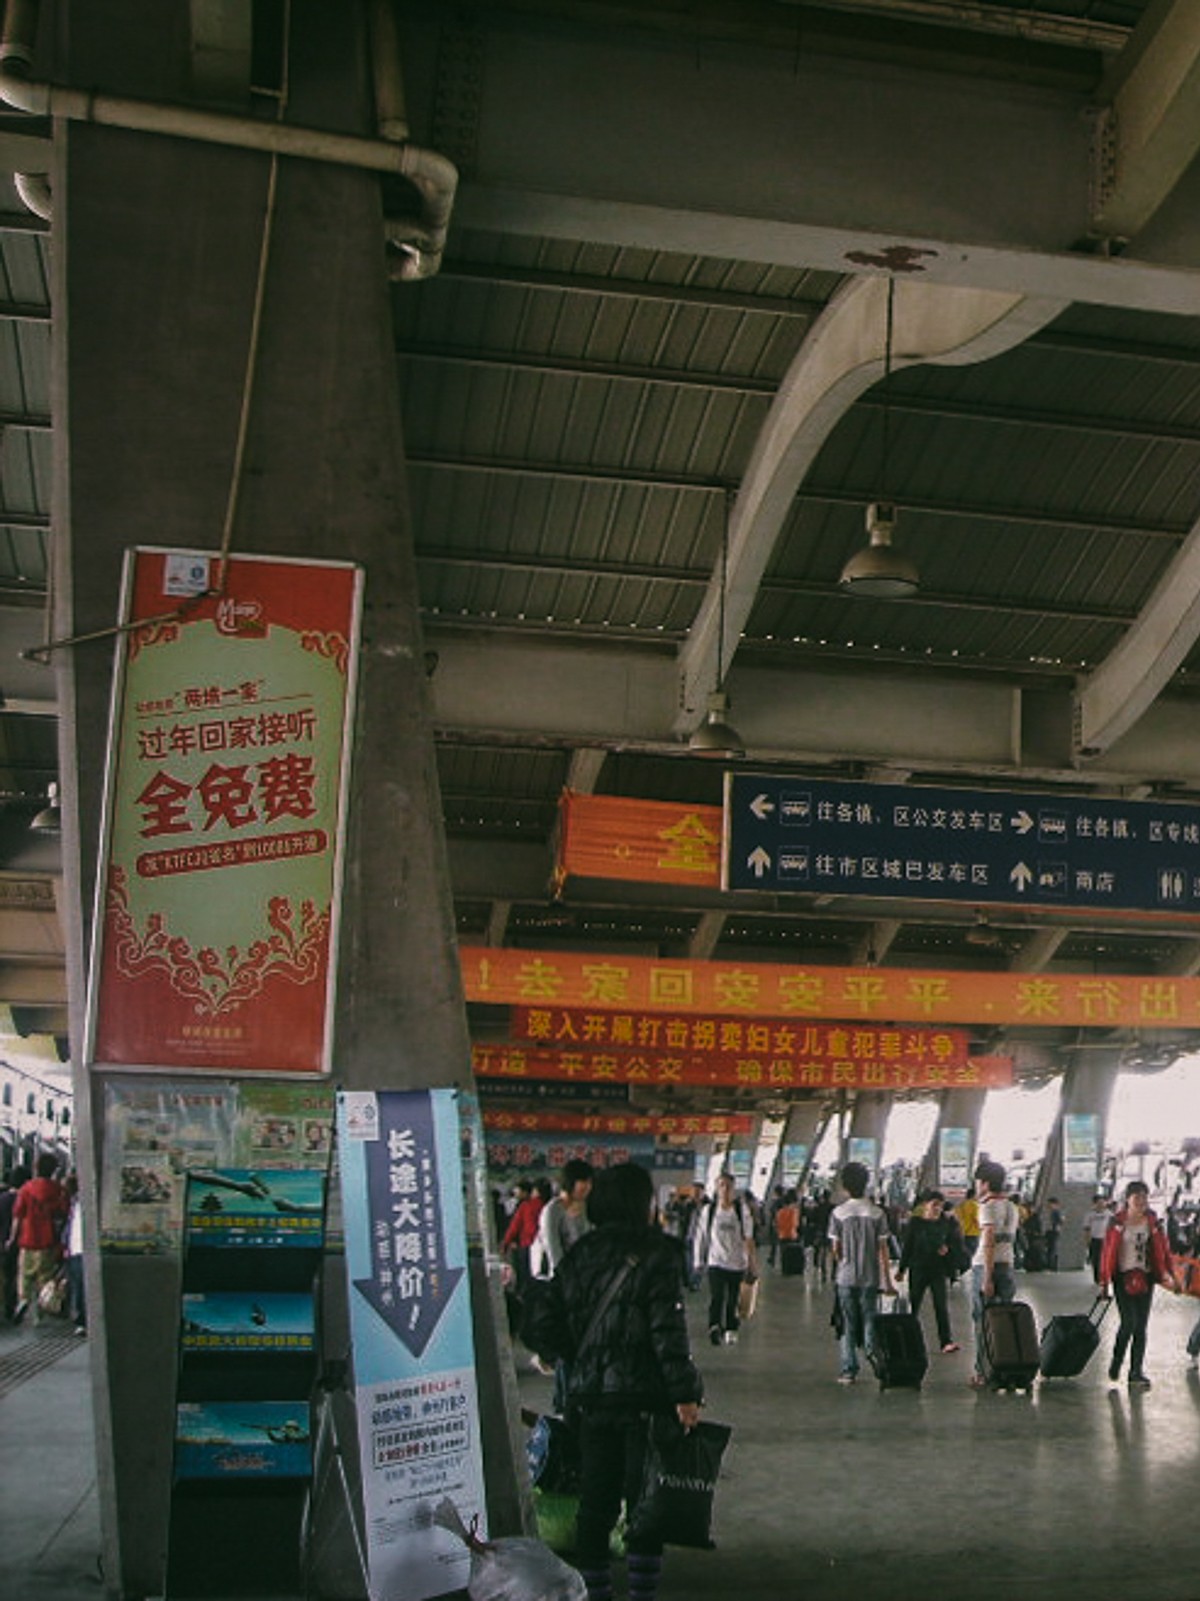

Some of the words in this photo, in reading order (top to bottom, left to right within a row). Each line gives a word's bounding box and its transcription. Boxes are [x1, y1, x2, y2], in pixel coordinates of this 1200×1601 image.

[138, 708, 317, 761] 过年回家接听
[134, 752, 318, 839] 全免费
[817, 801, 1003, 833] 往各镇、区公交发车区
[815, 853, 989, 885] 往市区城巴发车区
[1076, 870, 1116, 892] 商店
[527, 1009, 955, 1062] 深入开展打击拐卖妇女儿童犯罪斗争
[387, 1129, 426, 1331] 长途大降价！
